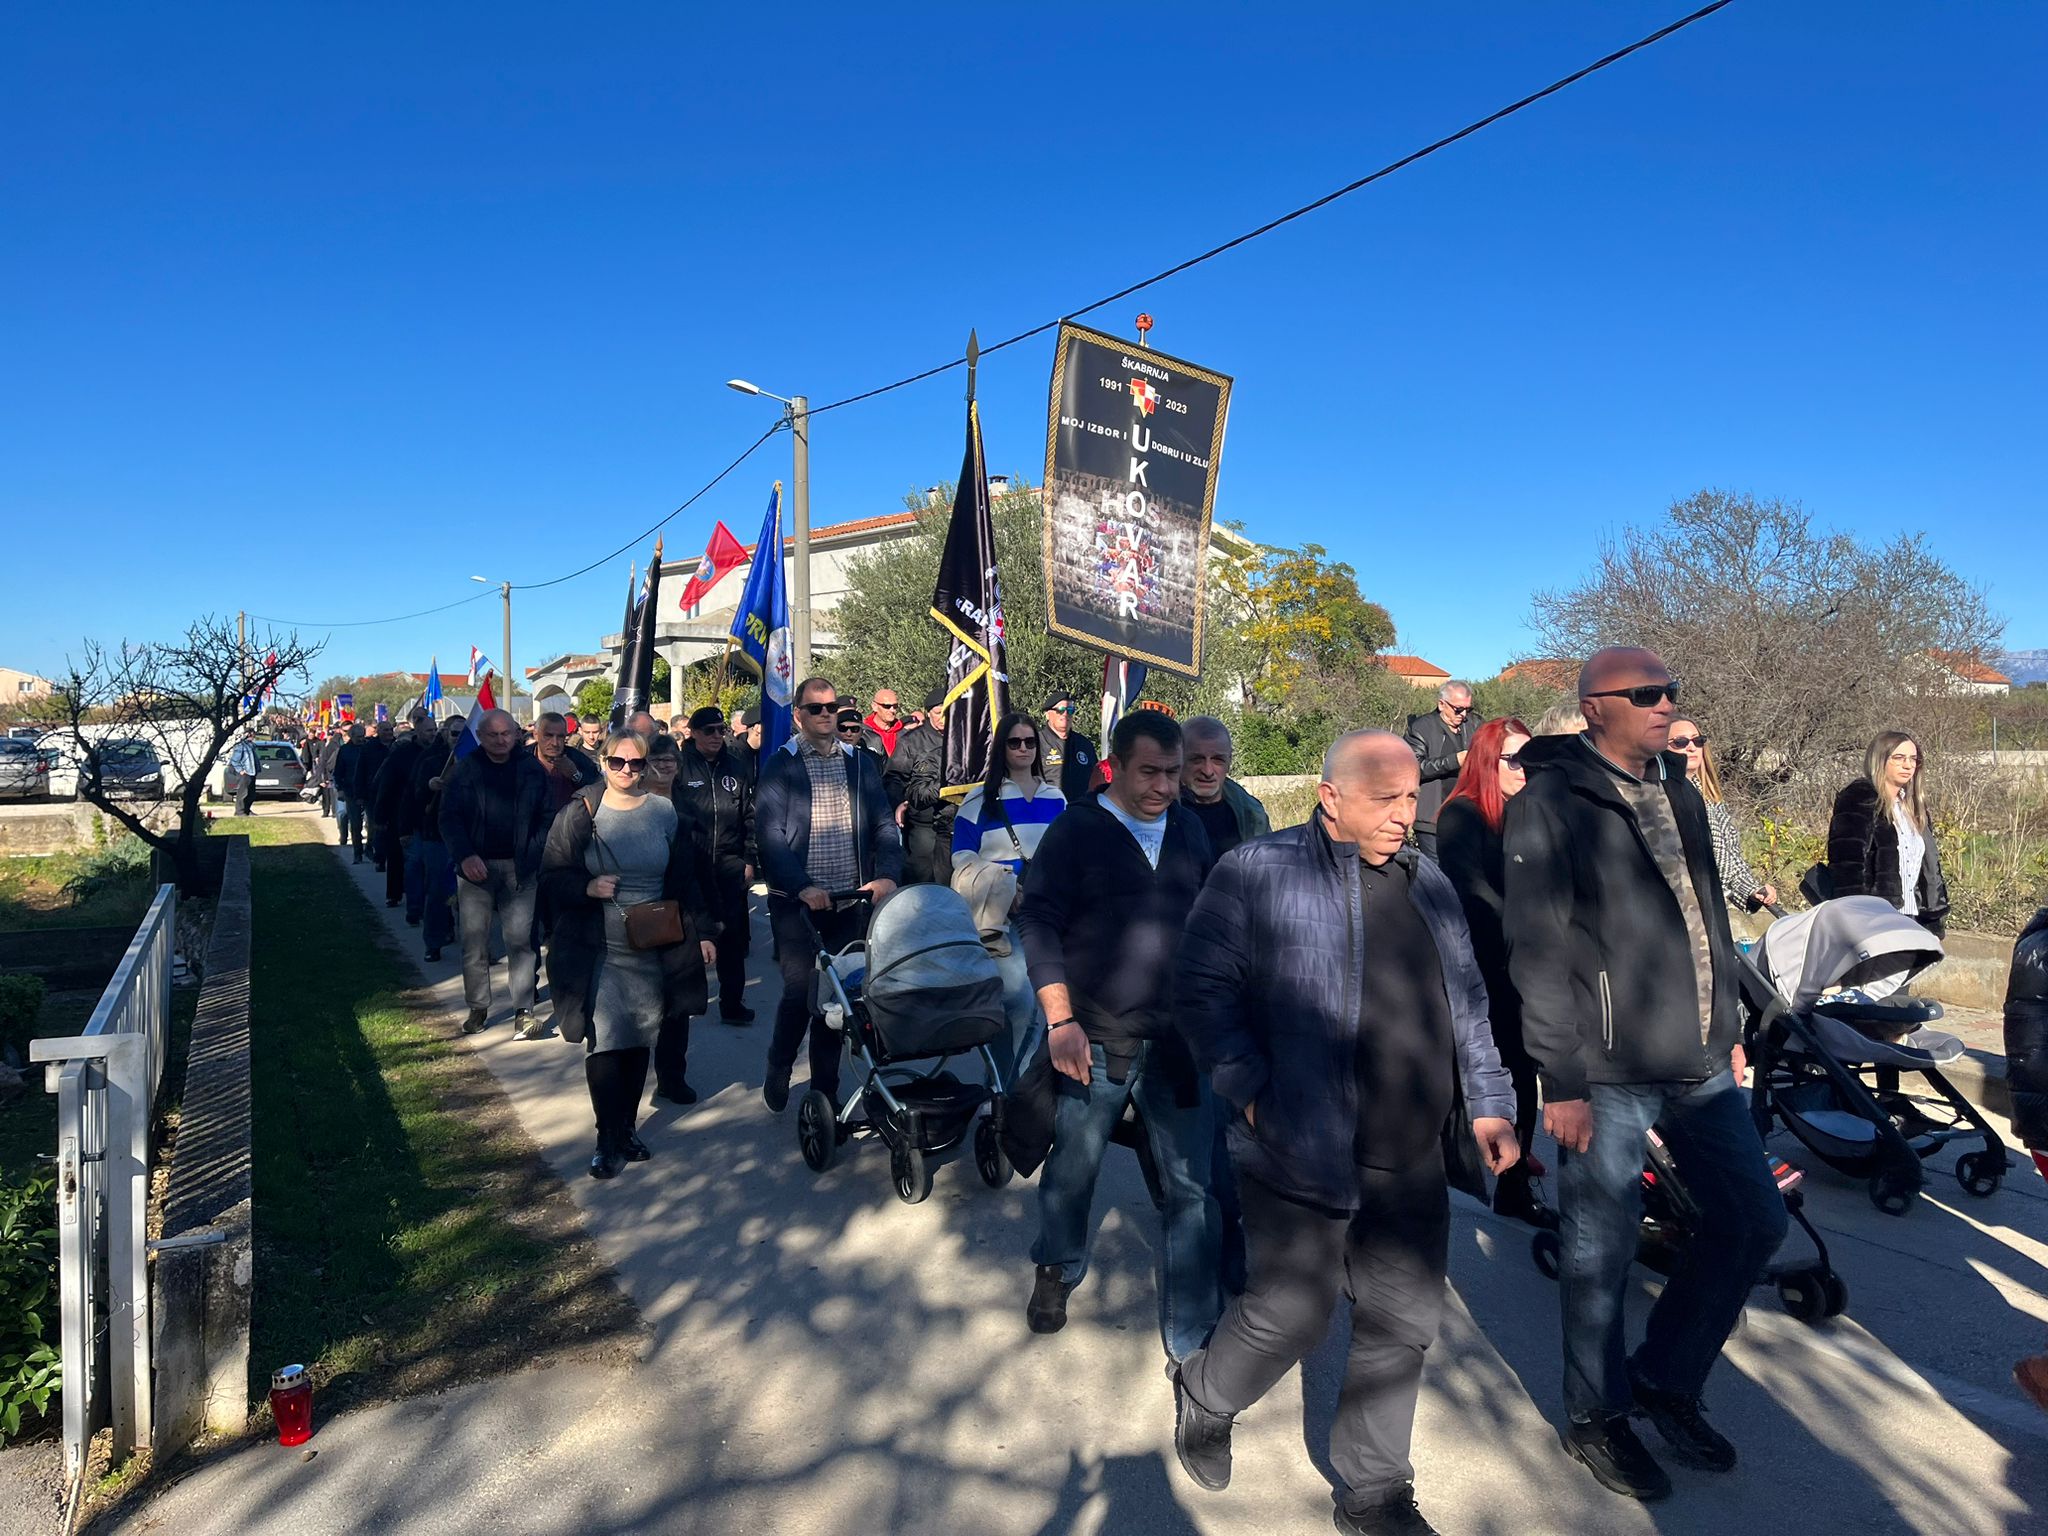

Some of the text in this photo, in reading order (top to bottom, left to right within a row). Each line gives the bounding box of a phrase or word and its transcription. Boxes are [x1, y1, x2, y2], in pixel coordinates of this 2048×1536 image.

[1121, 357, 1169, 382] ŠKABRNJA
[1099, 377, 1188, 414] 1991 2023
[1061, 416, 1127, 440] MOJ IZBOR I
[1151, 440, 1209, 469] DOBRU I U ZLU
